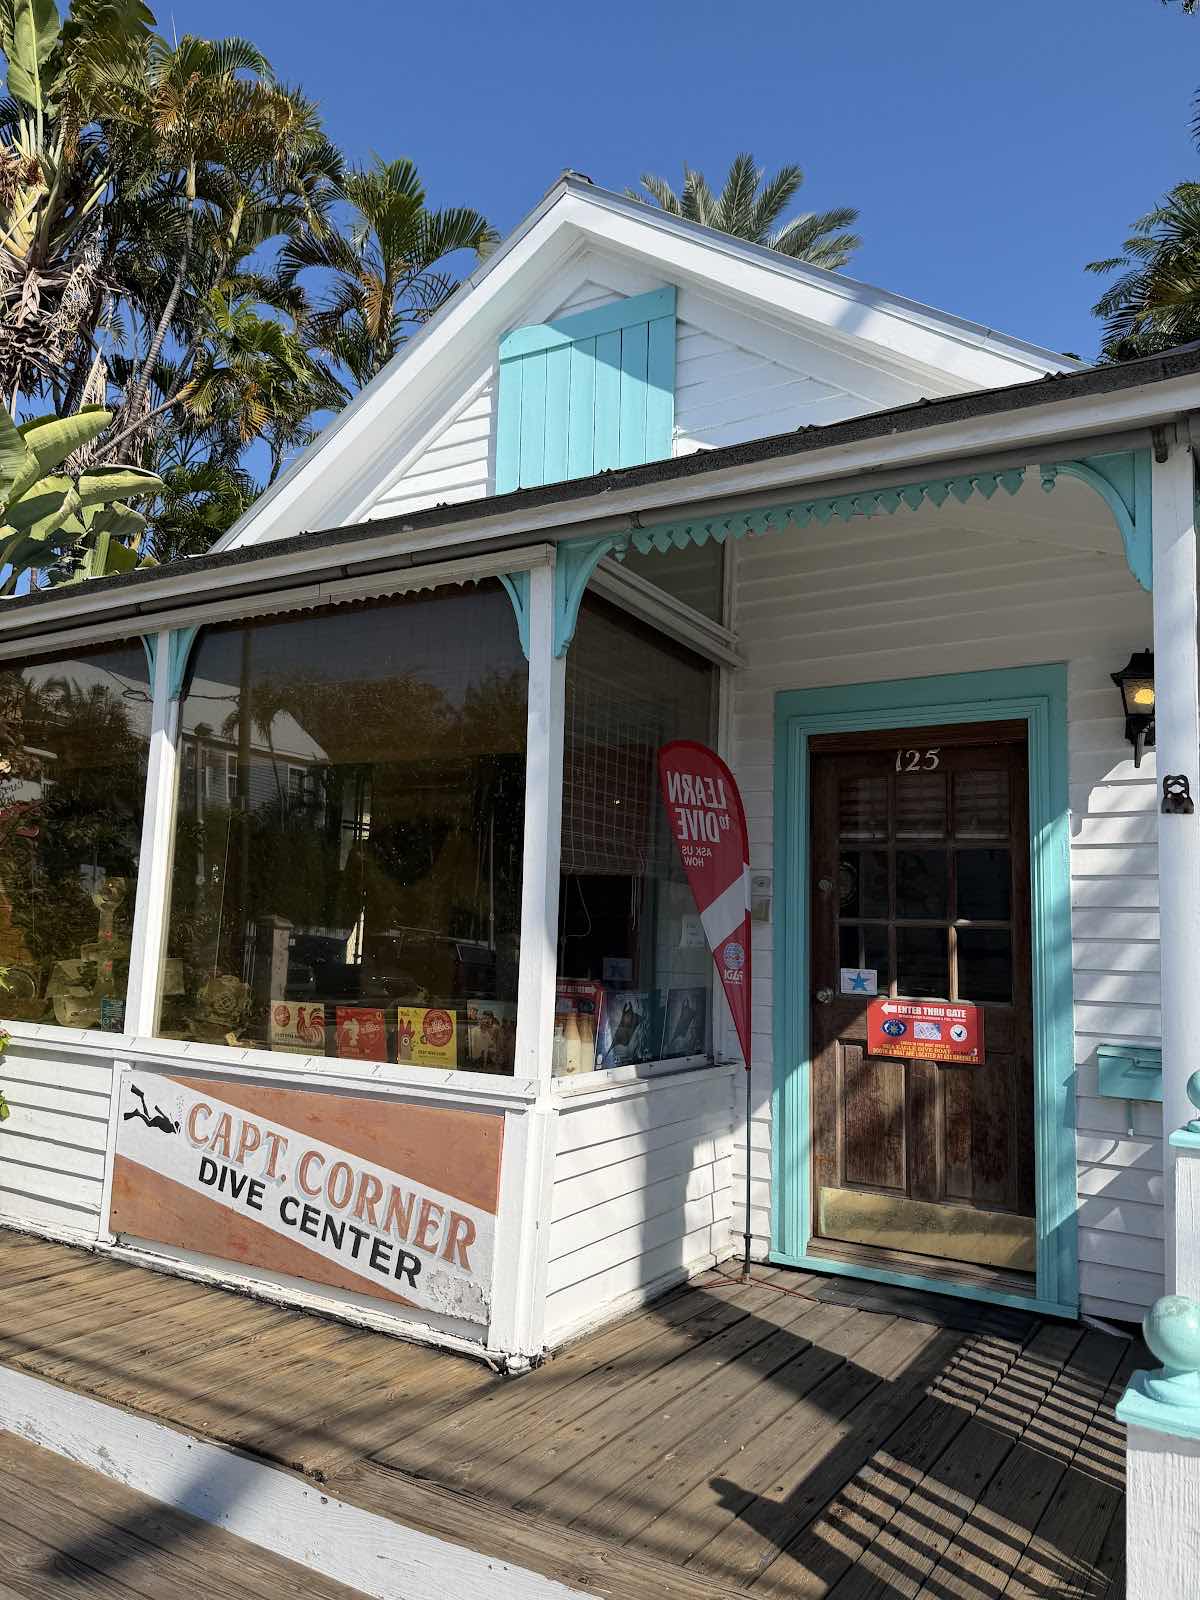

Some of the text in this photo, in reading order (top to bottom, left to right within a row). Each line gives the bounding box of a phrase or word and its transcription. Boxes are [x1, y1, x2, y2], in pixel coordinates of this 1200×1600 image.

[895, 748, 940, 771] 125
[897, 1005, 967, 1018] ENTER THRU GATE
[187, 1102, 476, 1272] CAPT. CORNER
[198, 1156, 422, 1289] DIVE CENTER
